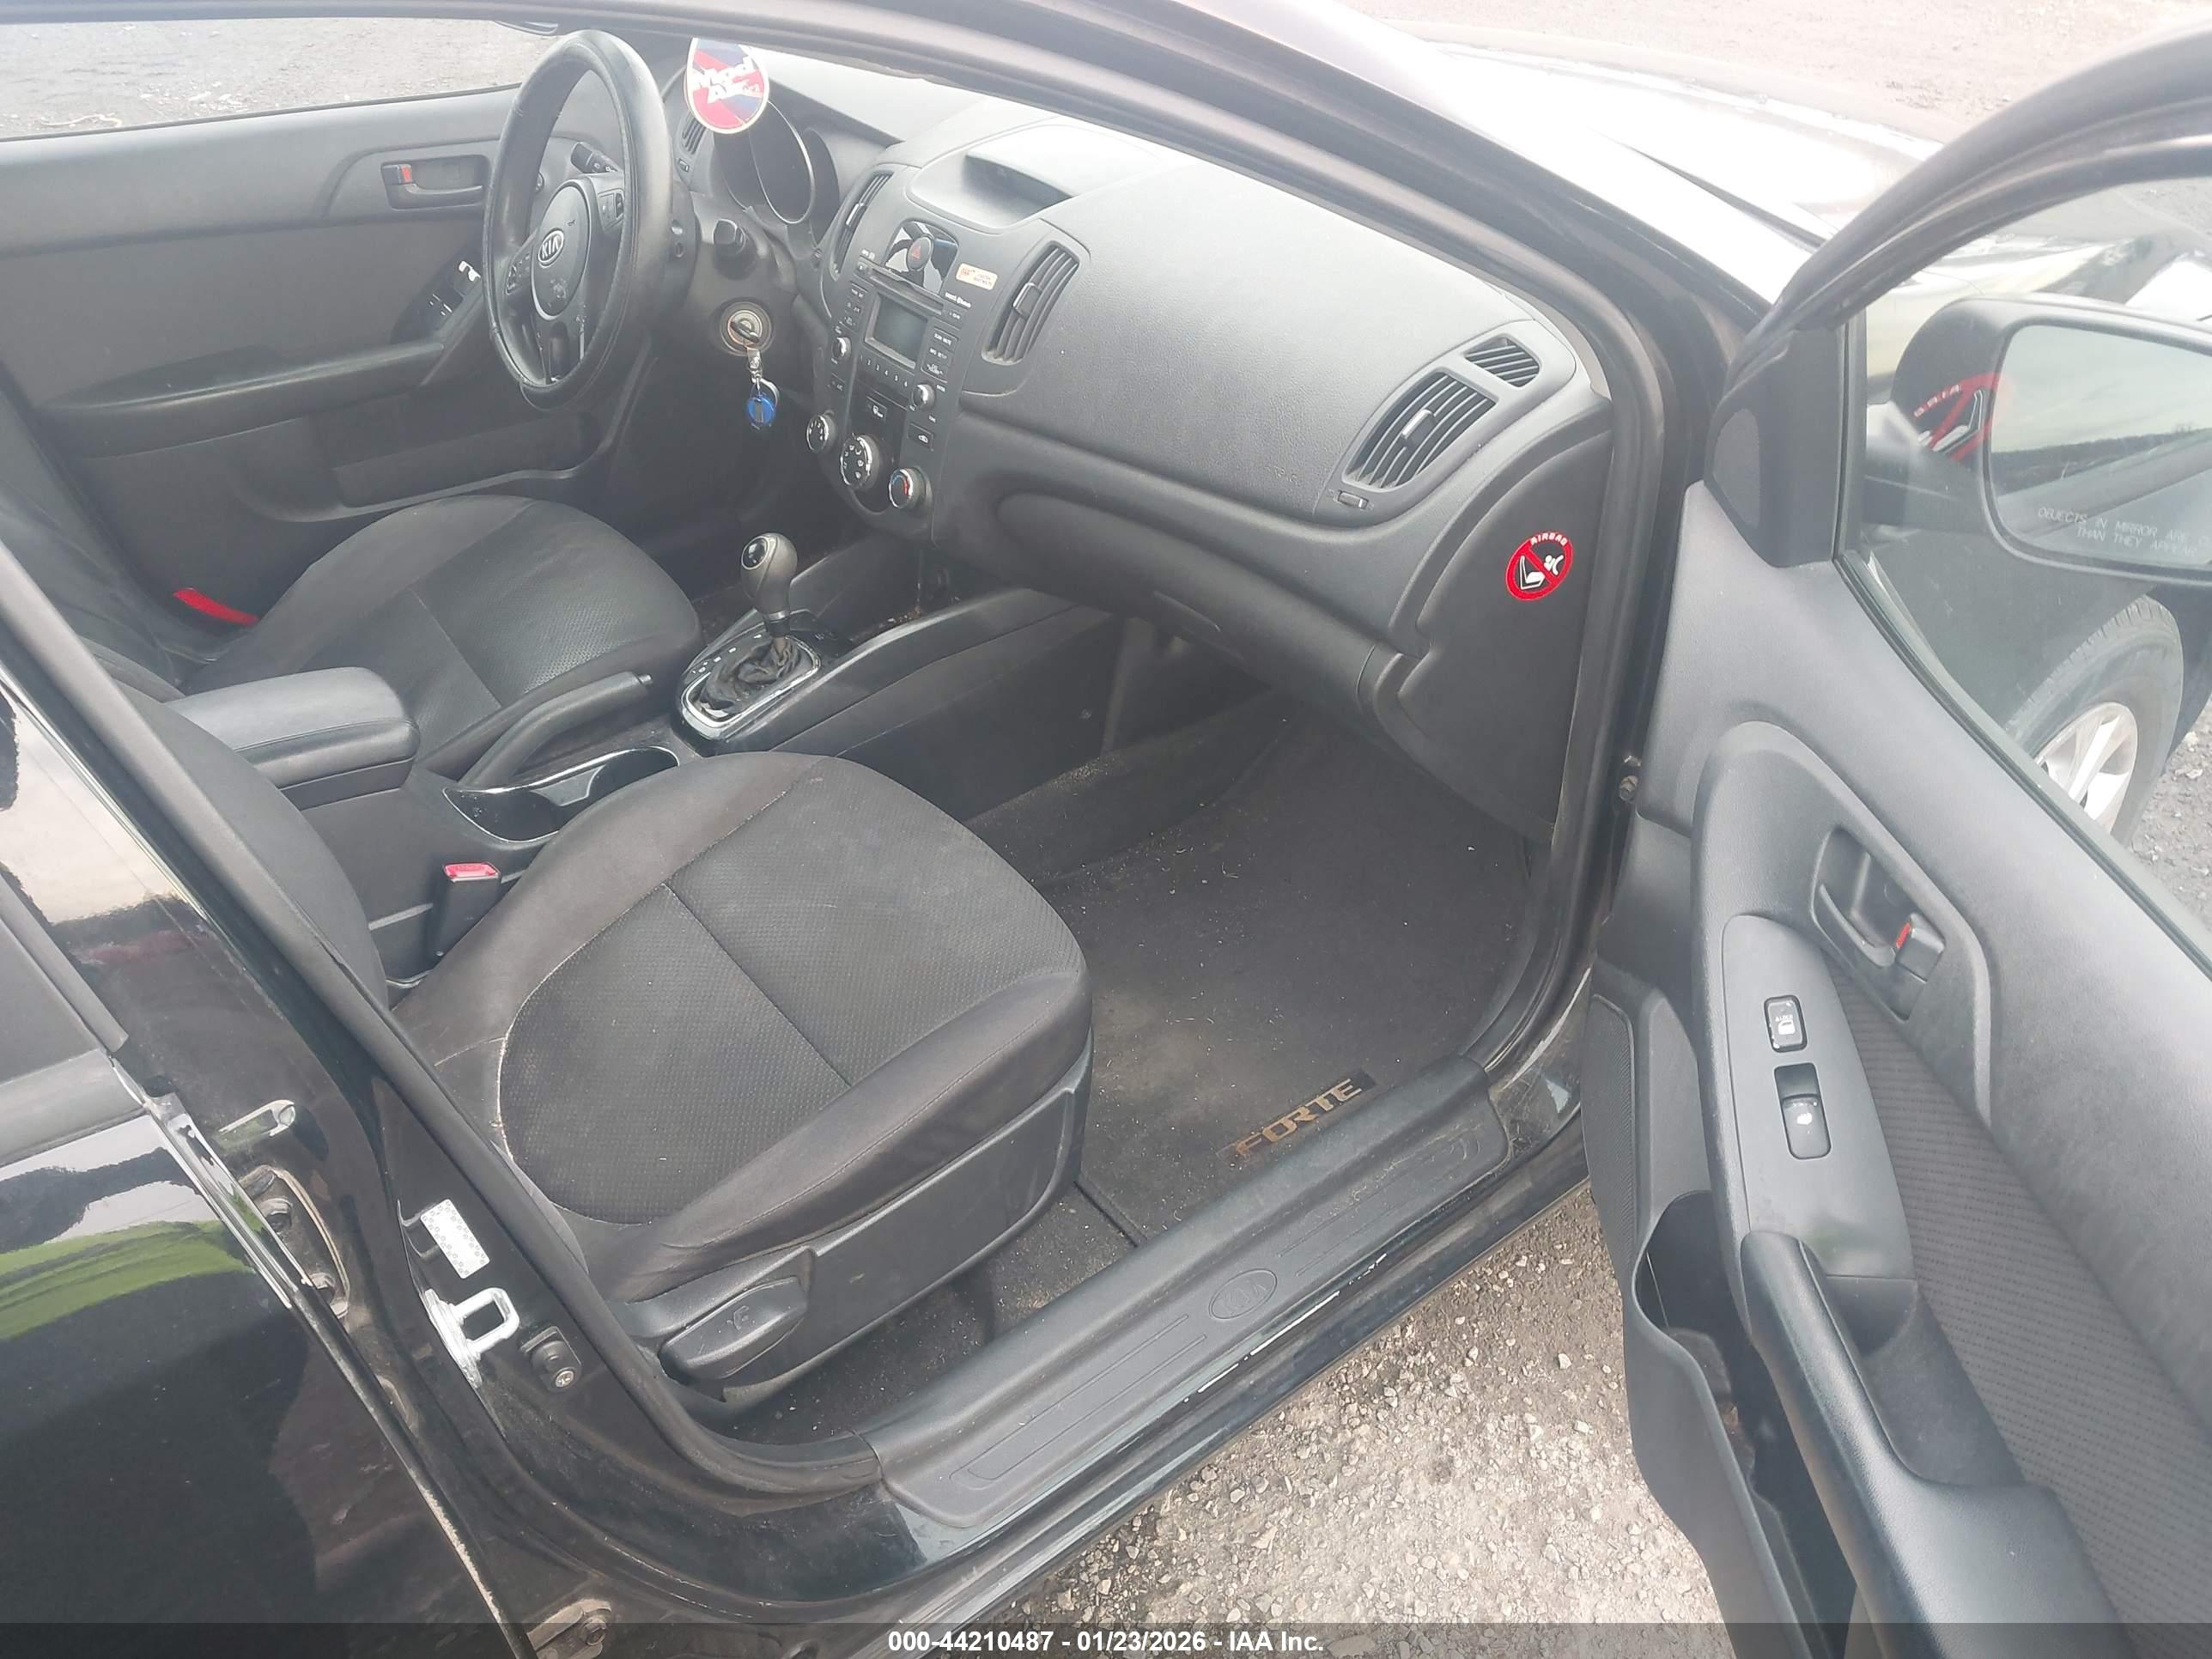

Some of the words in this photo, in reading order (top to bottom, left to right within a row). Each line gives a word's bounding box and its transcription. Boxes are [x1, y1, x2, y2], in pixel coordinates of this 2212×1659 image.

[542, 235, 560, 259] KIA
[2037, 507, 2088, 524] OBJECTS
[2115, 520, 2159, 538] MIRROR
[1530, 532, 1569, 546] AIRBAG
[2075, 526, 2106, 543] THAN
[2113, 532, 2143, 549] THEY
[1237, 1079, 1362, 1156] FORTE
